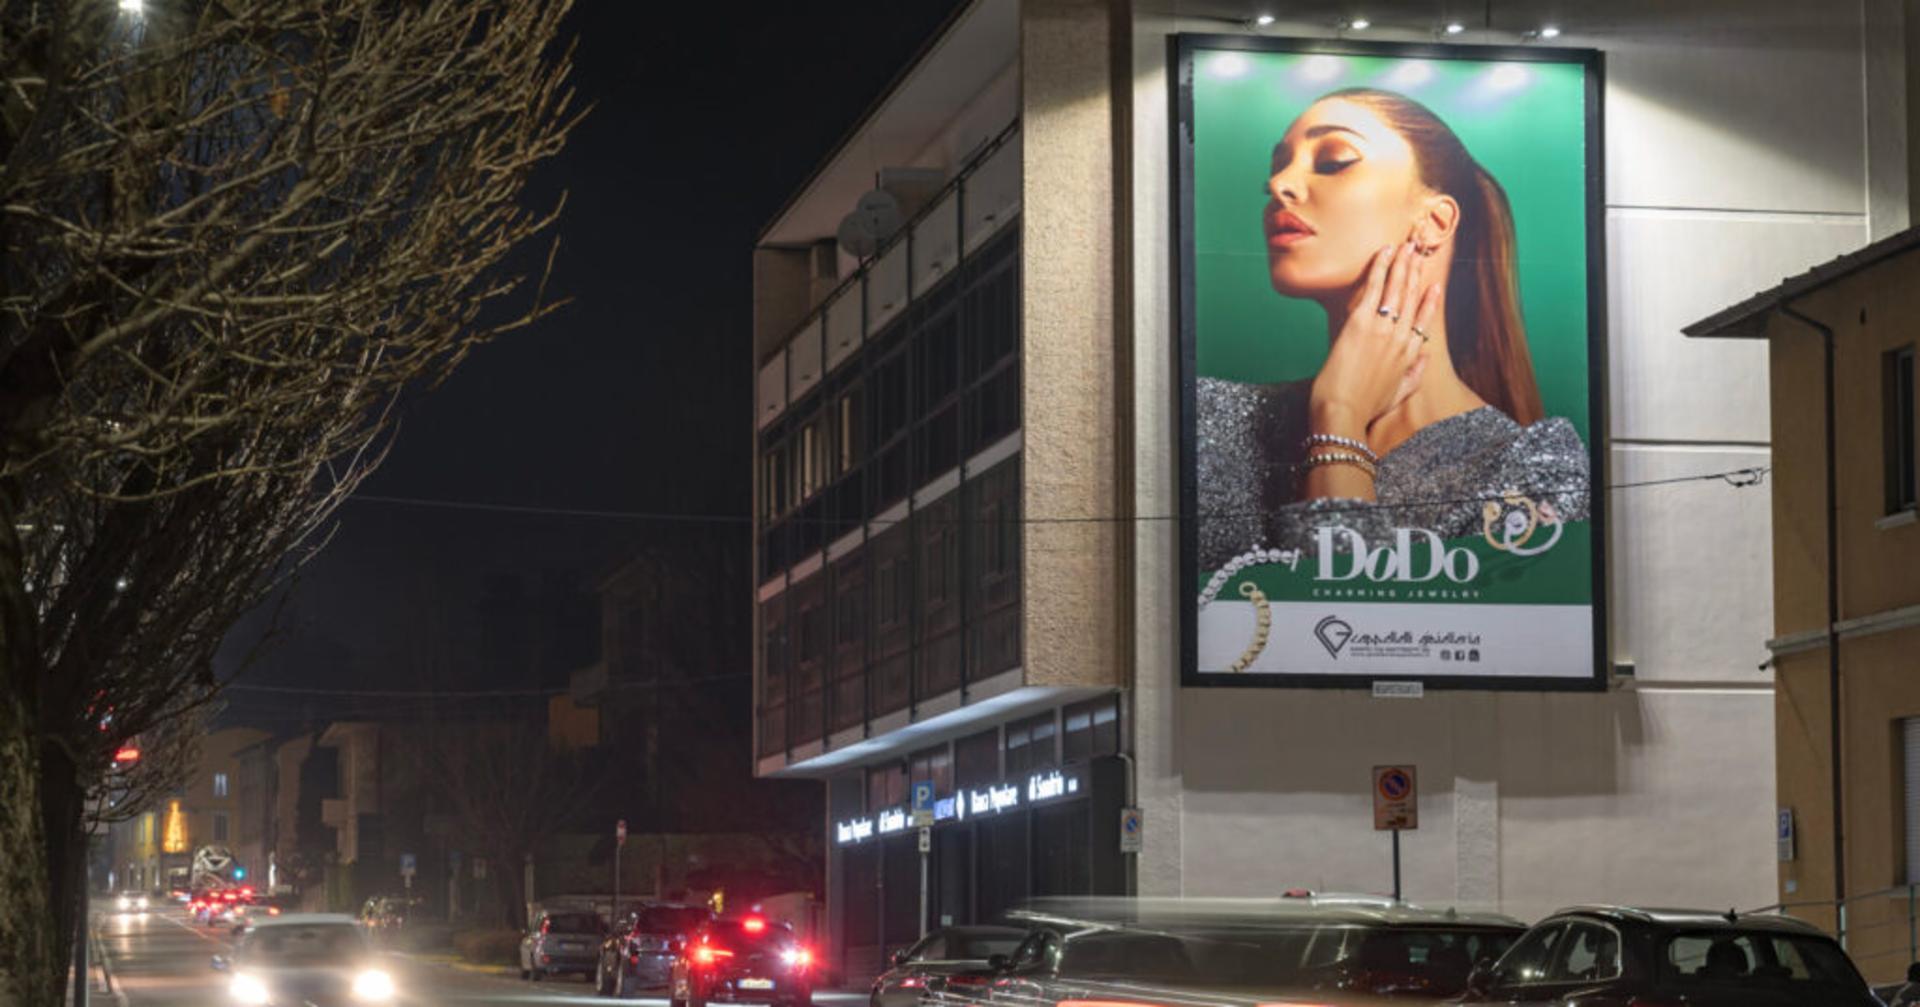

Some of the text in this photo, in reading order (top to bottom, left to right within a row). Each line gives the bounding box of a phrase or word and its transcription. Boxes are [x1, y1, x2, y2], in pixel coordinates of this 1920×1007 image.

[1313, 526, 1480, 583] DoDo
[1313, 588, 1480, 599] CHARMING JEWELRY
[917, 786, 929, 809] P
